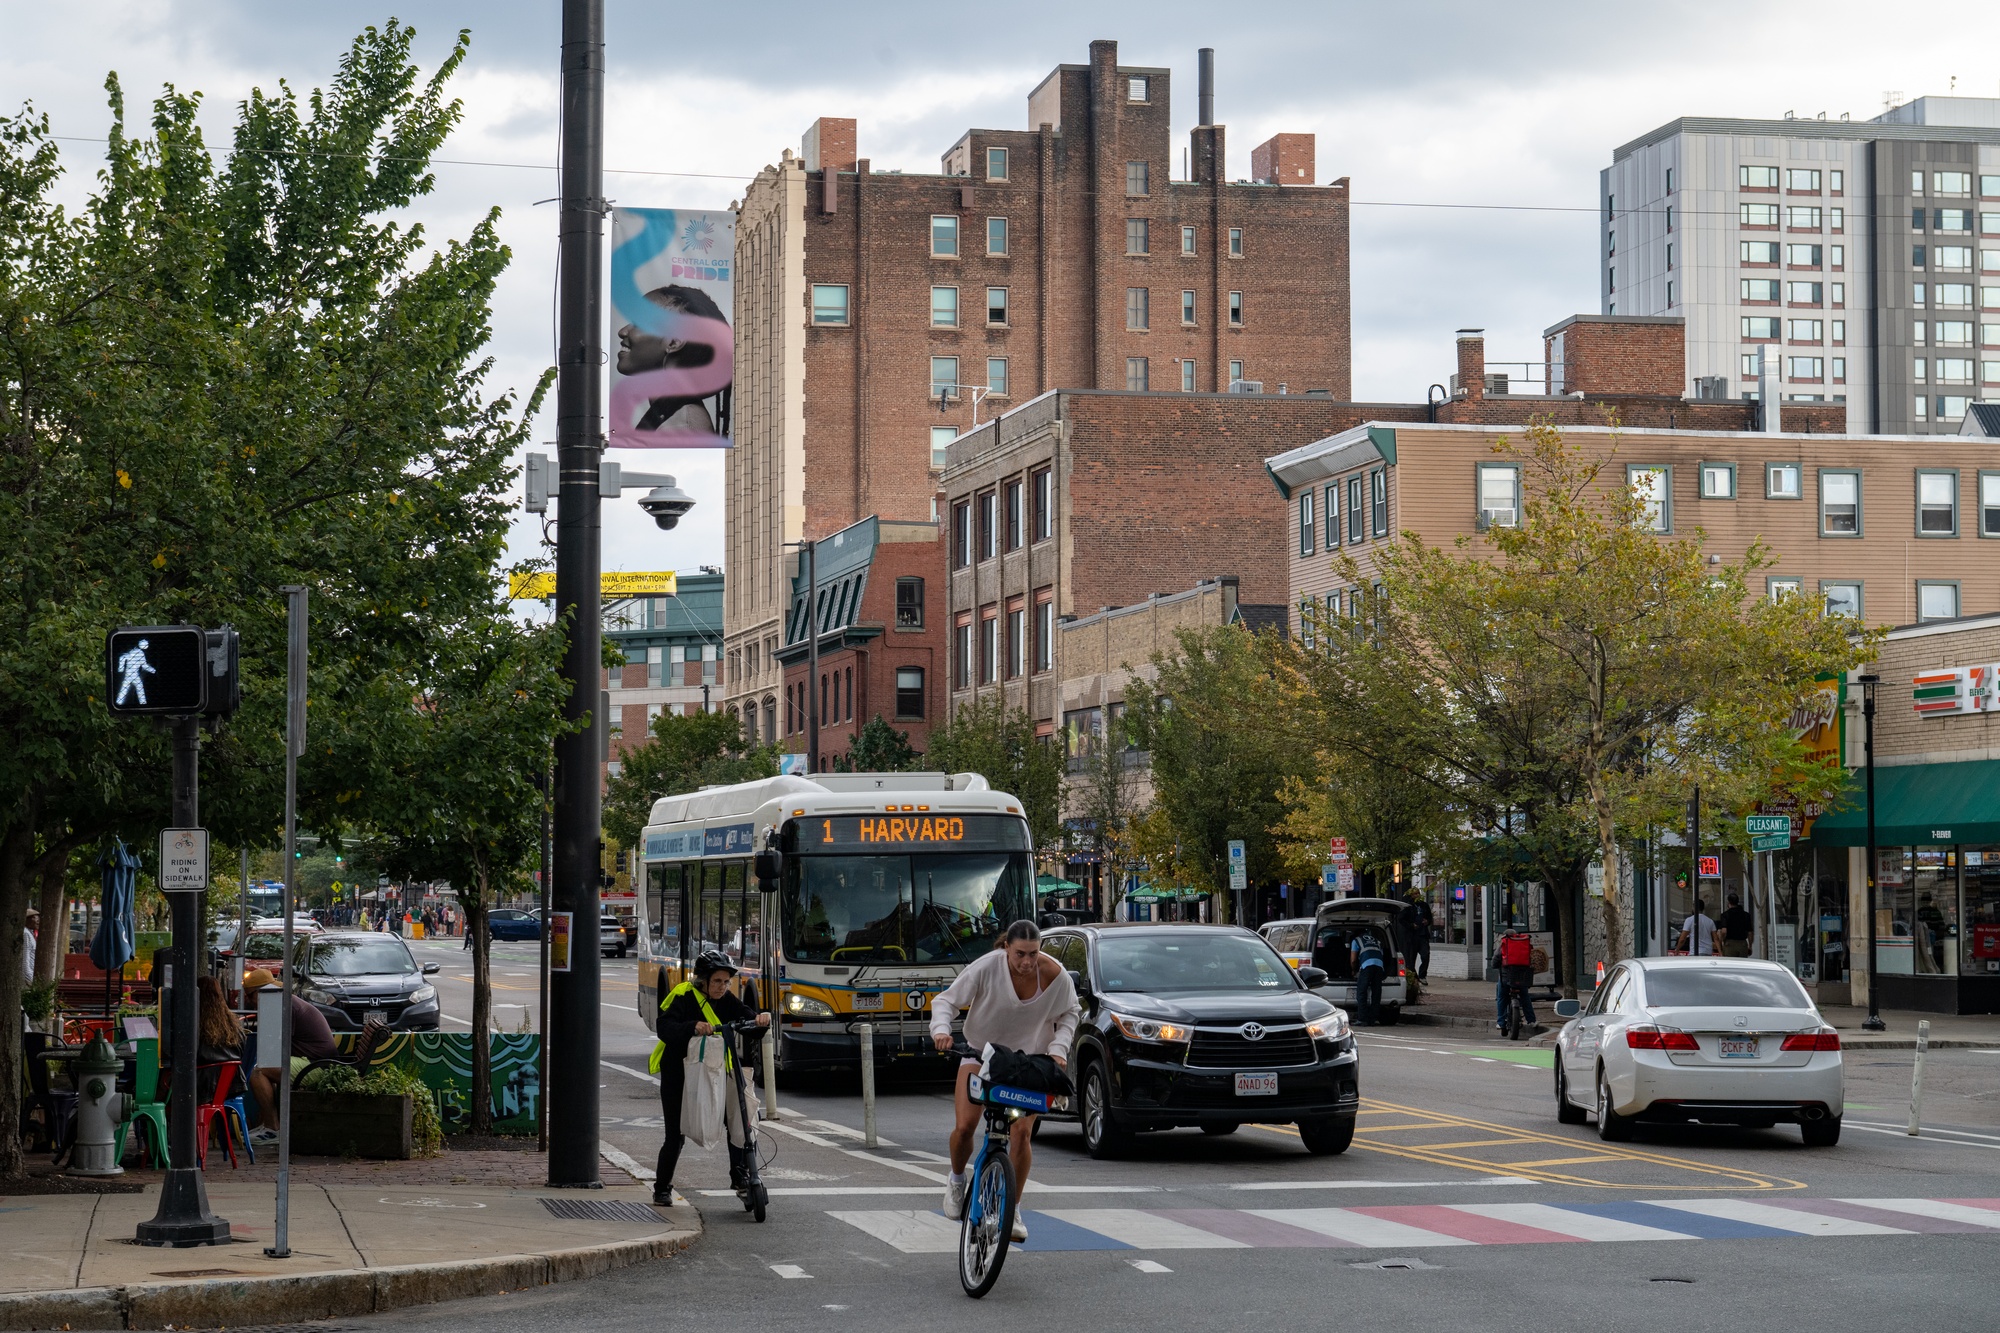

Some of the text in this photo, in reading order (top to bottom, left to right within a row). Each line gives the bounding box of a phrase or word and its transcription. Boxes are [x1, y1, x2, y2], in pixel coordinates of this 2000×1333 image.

[671, 256, 729, 267] CENTRAL GOT
[671, 264, 730, 282] PRIDE
[600, 574, 672, 583] NIVAL INTERNATIONAL
[822, 817, 964, 843] 1 HARVARD
[1749, 819, 1789, 831] PLEASANT ST
[864, 996, 882, 1007] 1866
[1721, 1042, 1758, 1053] 2CKF 87
[1237, 1078, 1276, 1090] 4NAD 96
[999, 1090, 1042, 1106] BLUEbikes
